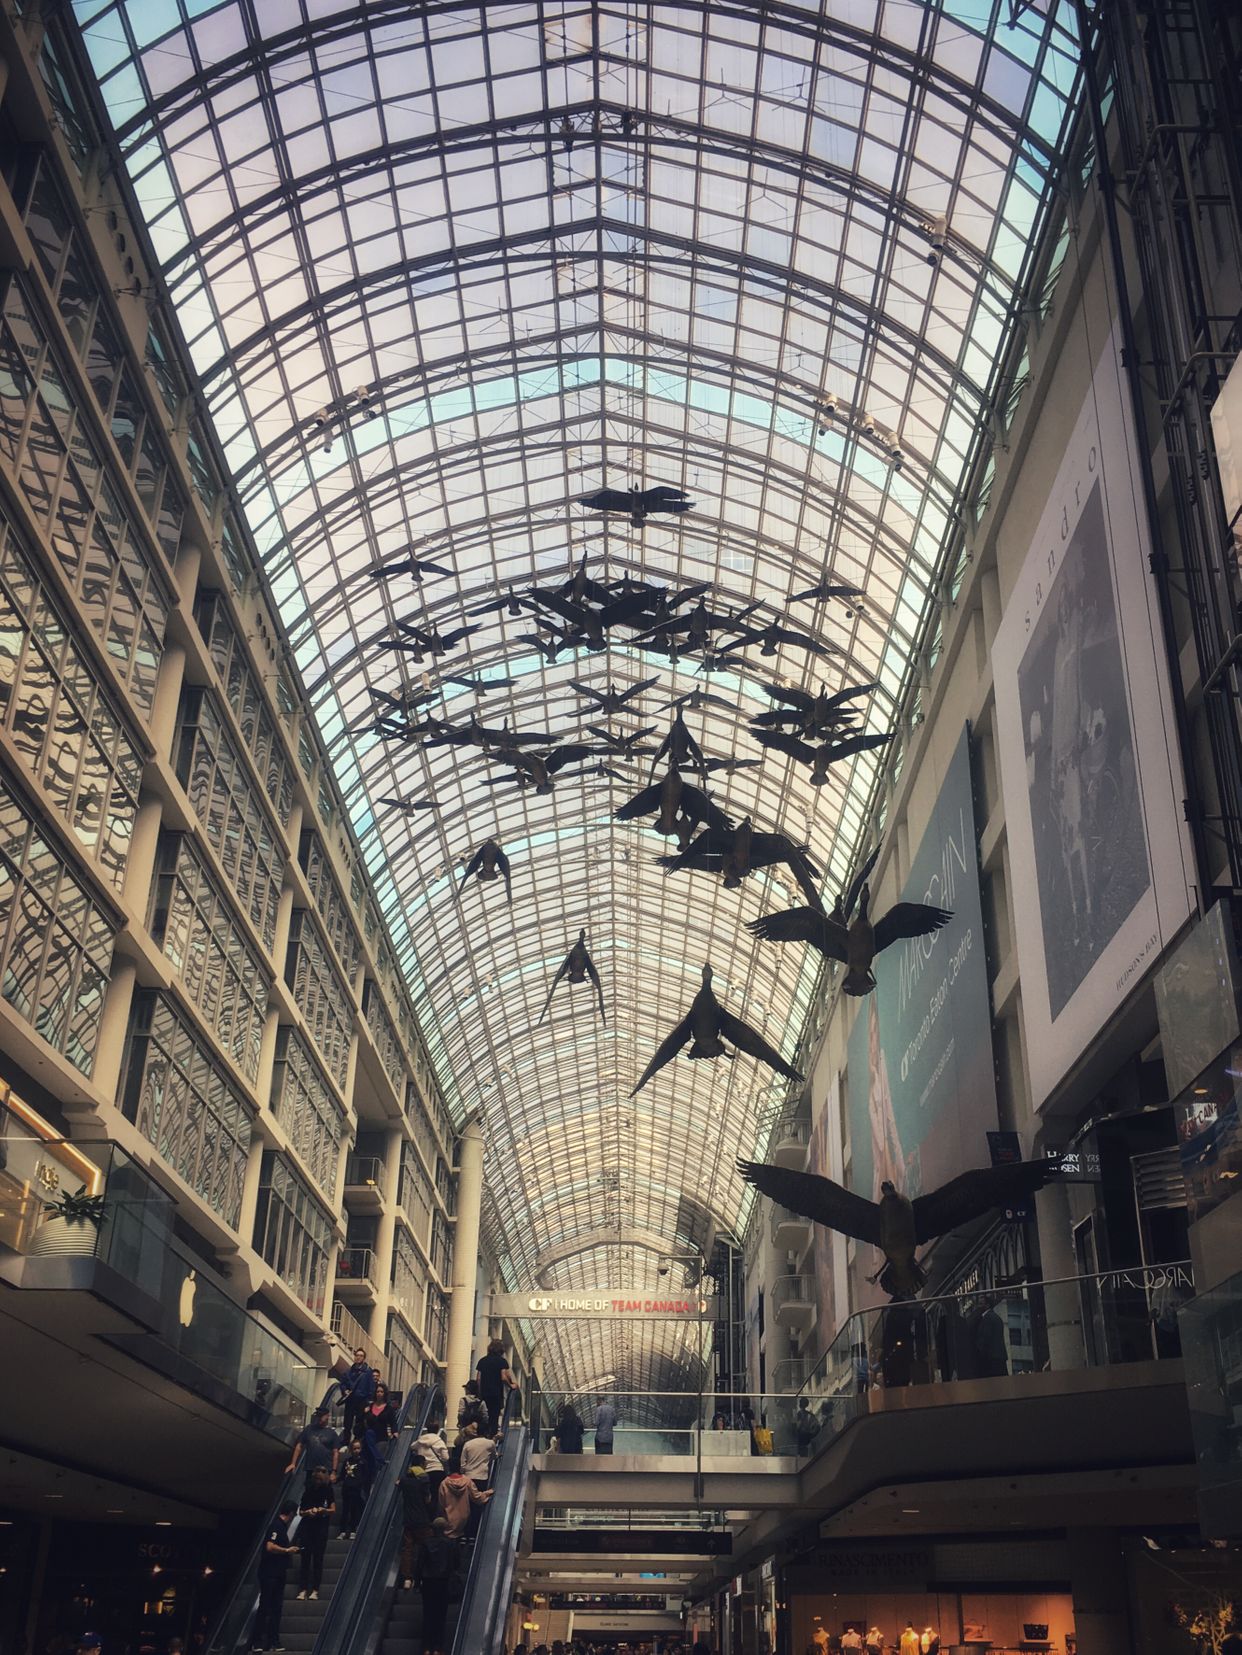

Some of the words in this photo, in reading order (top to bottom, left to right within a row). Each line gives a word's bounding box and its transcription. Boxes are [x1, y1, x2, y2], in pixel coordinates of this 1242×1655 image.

[1025, 445, 1097, 632] sandro
[907, 1014, 932, 1065] Toronto
[929, 977, 949, 1023] Eaton
[948, 927, 973, 986] Centre
[528, 1297, 553, 1312] CF
[560, 1298, 592, 1312] HOME
[594, 1299, 609, 1312] OF
[611, 1299, 642, 1313] TEAM
[644, 1300, 691, 1314] CANADA
[817, 1551, 929, 1568] RINASCIMENTO
